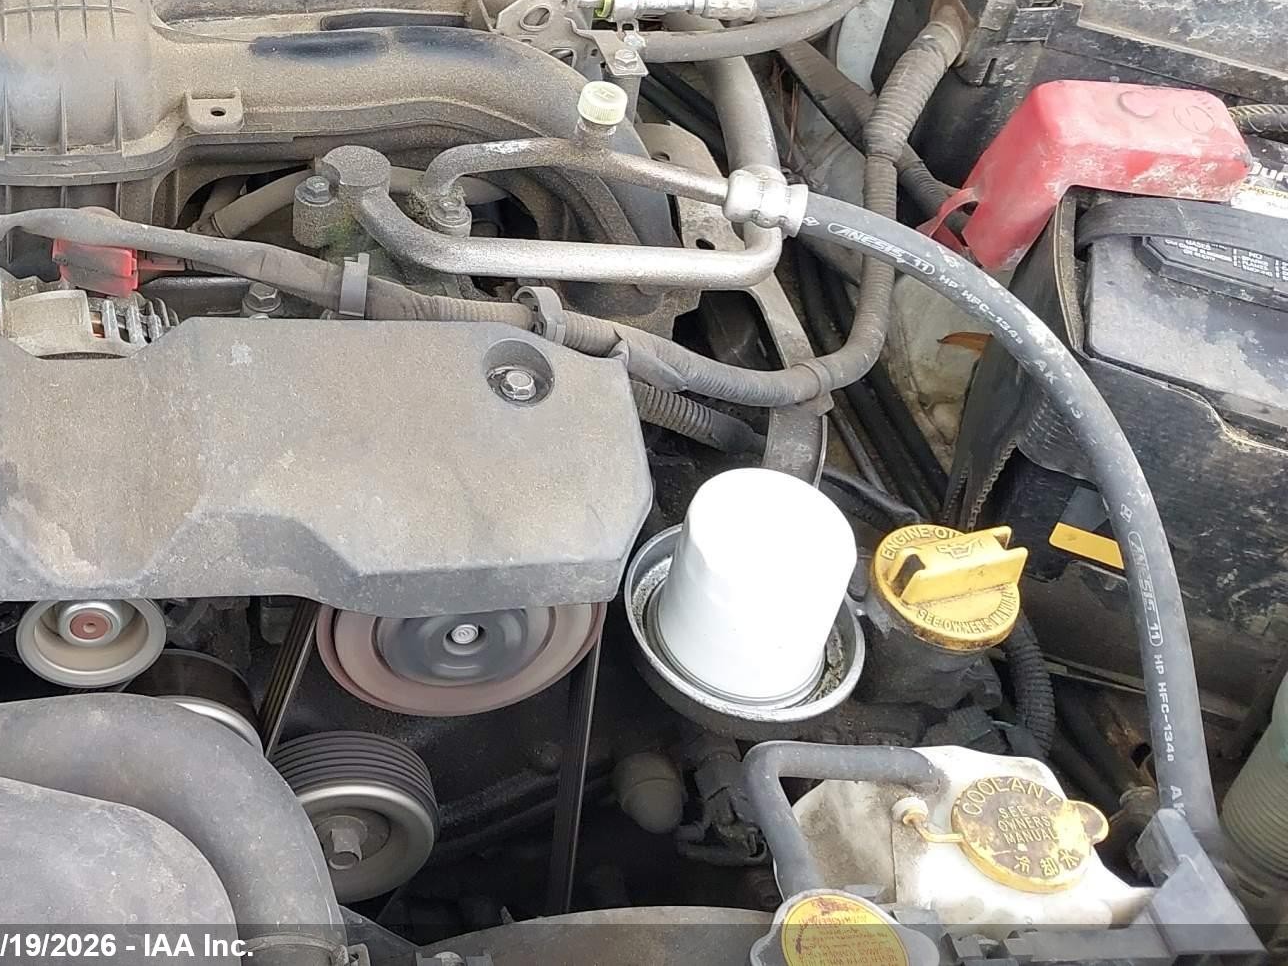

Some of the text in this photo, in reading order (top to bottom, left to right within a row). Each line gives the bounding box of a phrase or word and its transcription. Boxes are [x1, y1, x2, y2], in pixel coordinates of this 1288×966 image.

[939, 274, 959, 289] HP
[880, 526, 931, 561] ENGINE
[917, 608, 941, 628] SEE
[943, 617, 994, 635] OWNER'S
[1153, 653, 1165, 675] HP
[1157, 681, 1175, 762] HFC-134a
[962, 776, 1062, 816] COOLANT
[997, 804, 1030, 820] SEE
[997, 814, 1051, 832] OWNERS
[1003, 827, 1060, 845] MANUAL
